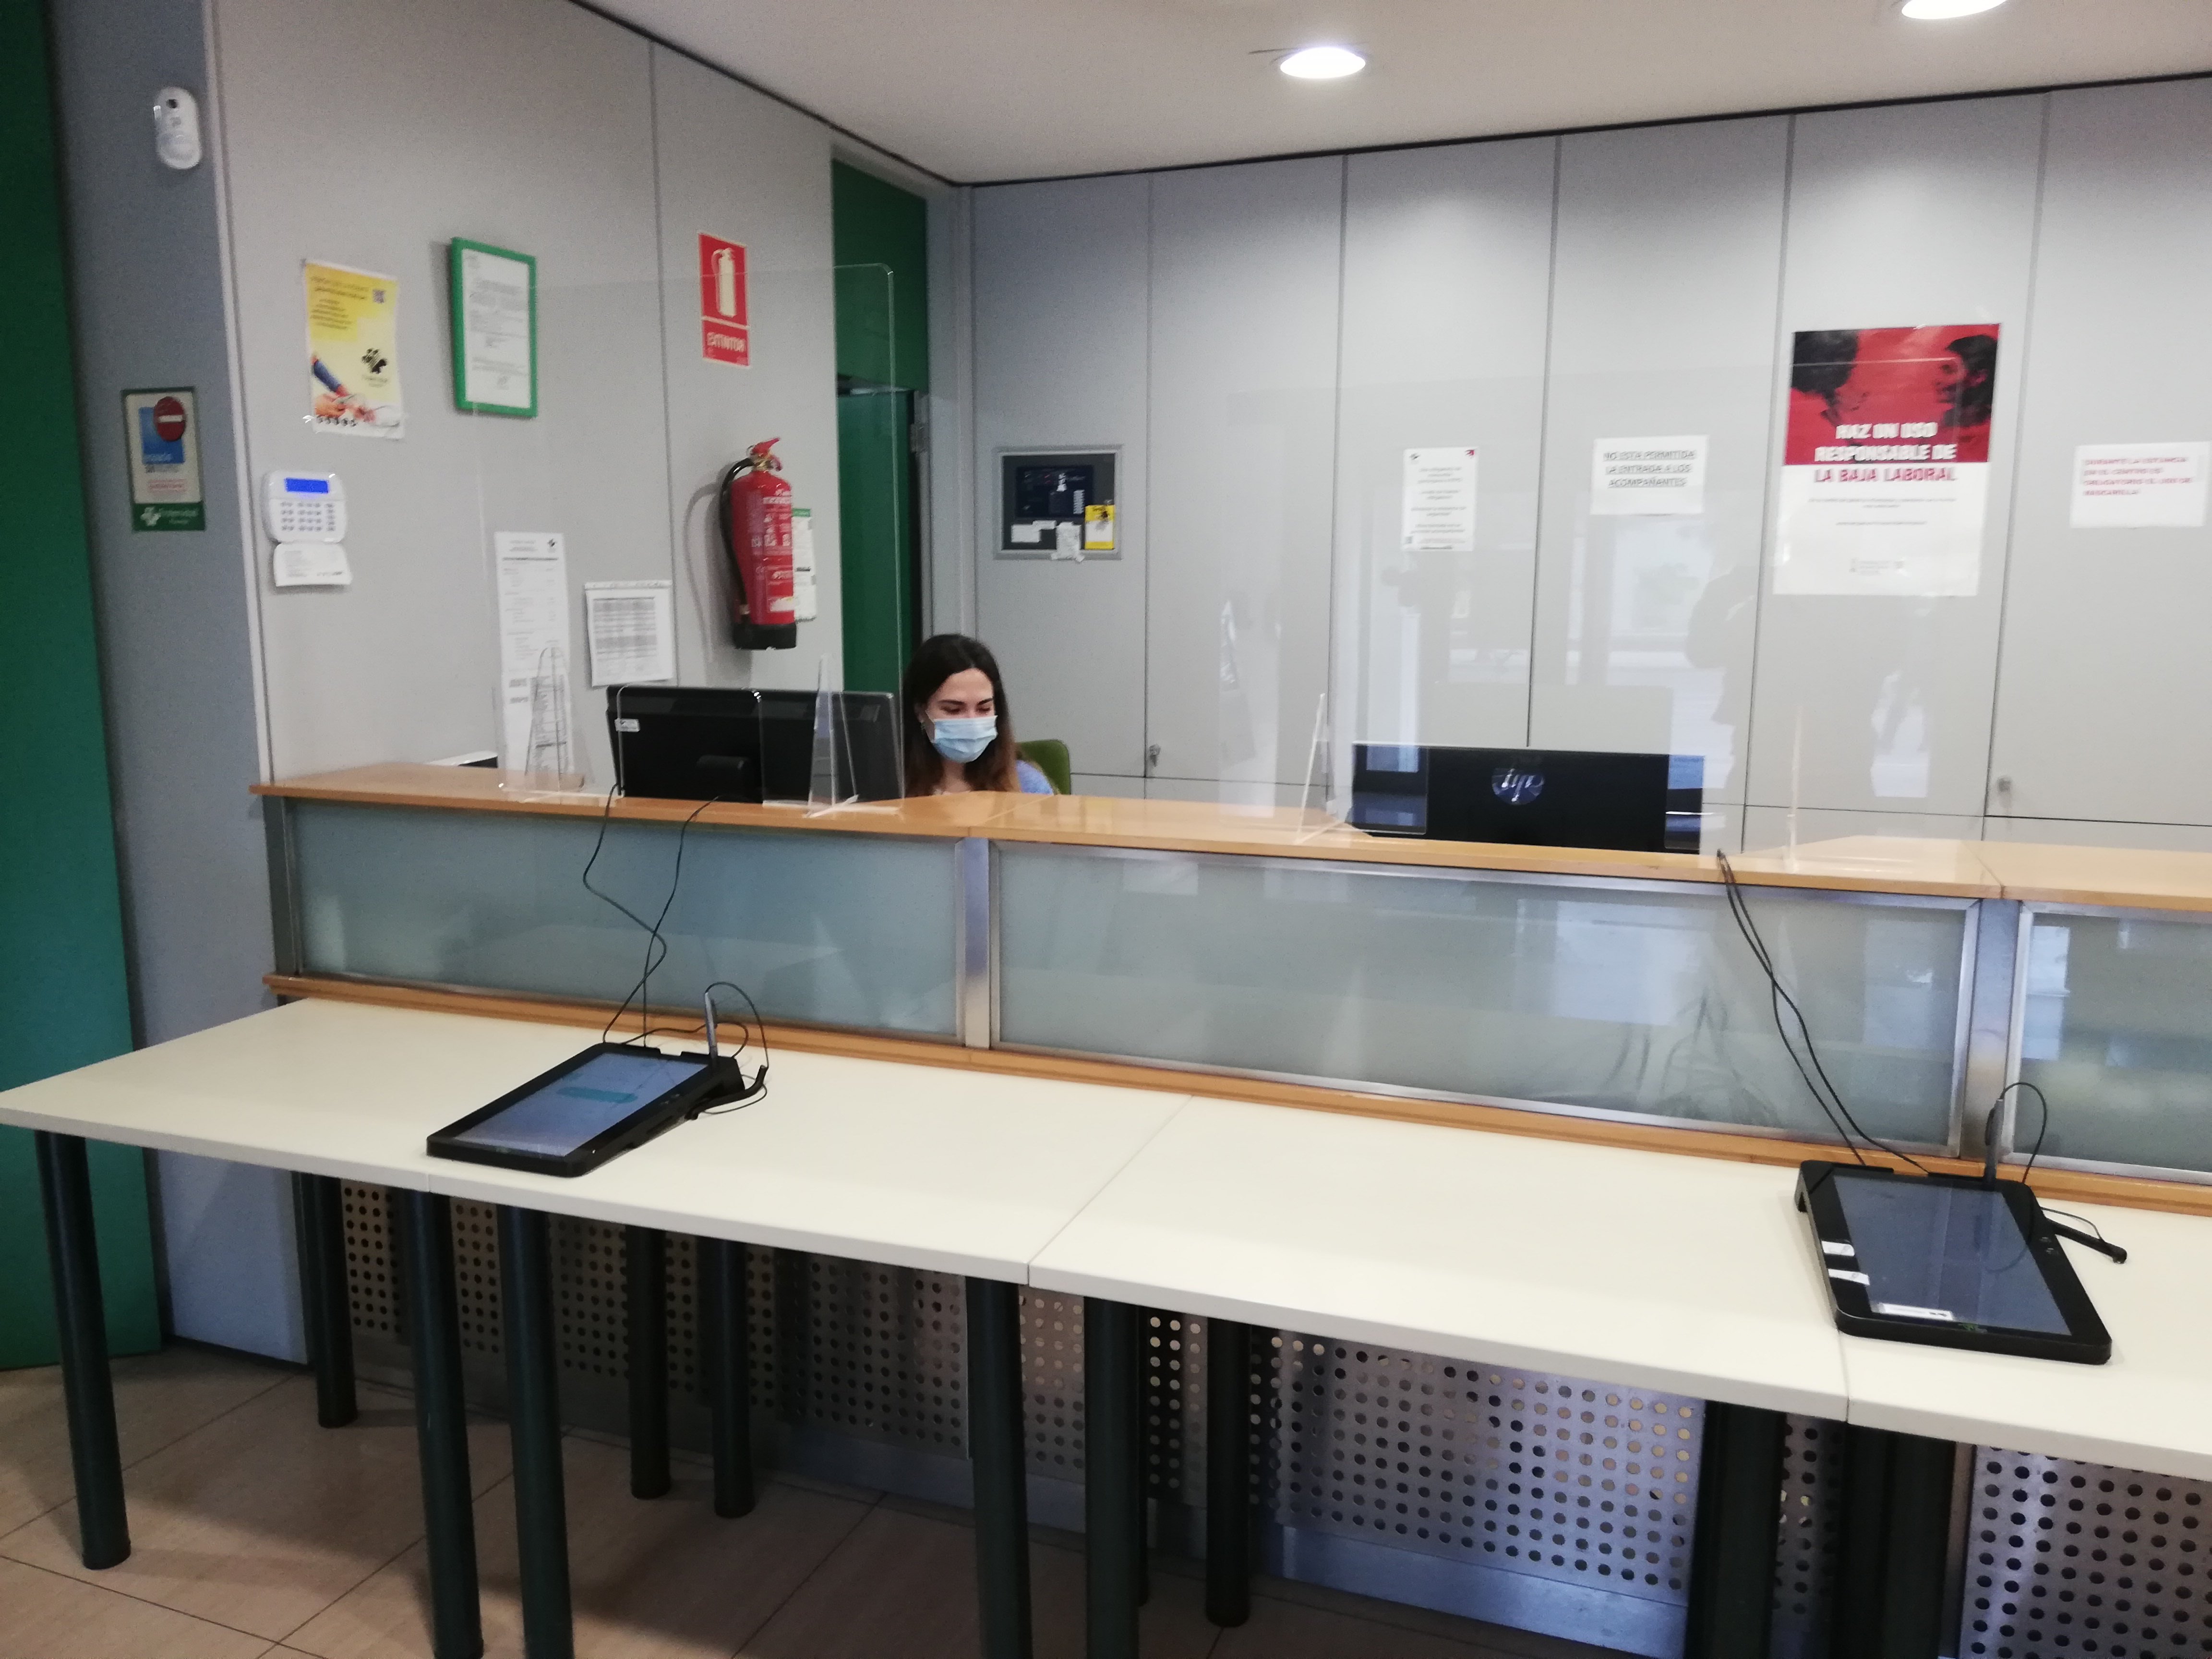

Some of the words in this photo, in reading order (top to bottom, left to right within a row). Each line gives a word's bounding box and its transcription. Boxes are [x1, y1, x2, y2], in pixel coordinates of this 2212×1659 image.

[1836, 424, 1872, 439] HAZ
[1873, 423, 1899, 438] UN
[1900, 422, 1938, 438] USO
[1815, 445, 1931, 461] RESPONSABLE
[1932, 444, 1957, 459] DE
[1815, 469, 1833, 482] LA
[1838, 468, 1877, 482] BAJA
[1883, 468, 1957, 481] LABORAL
